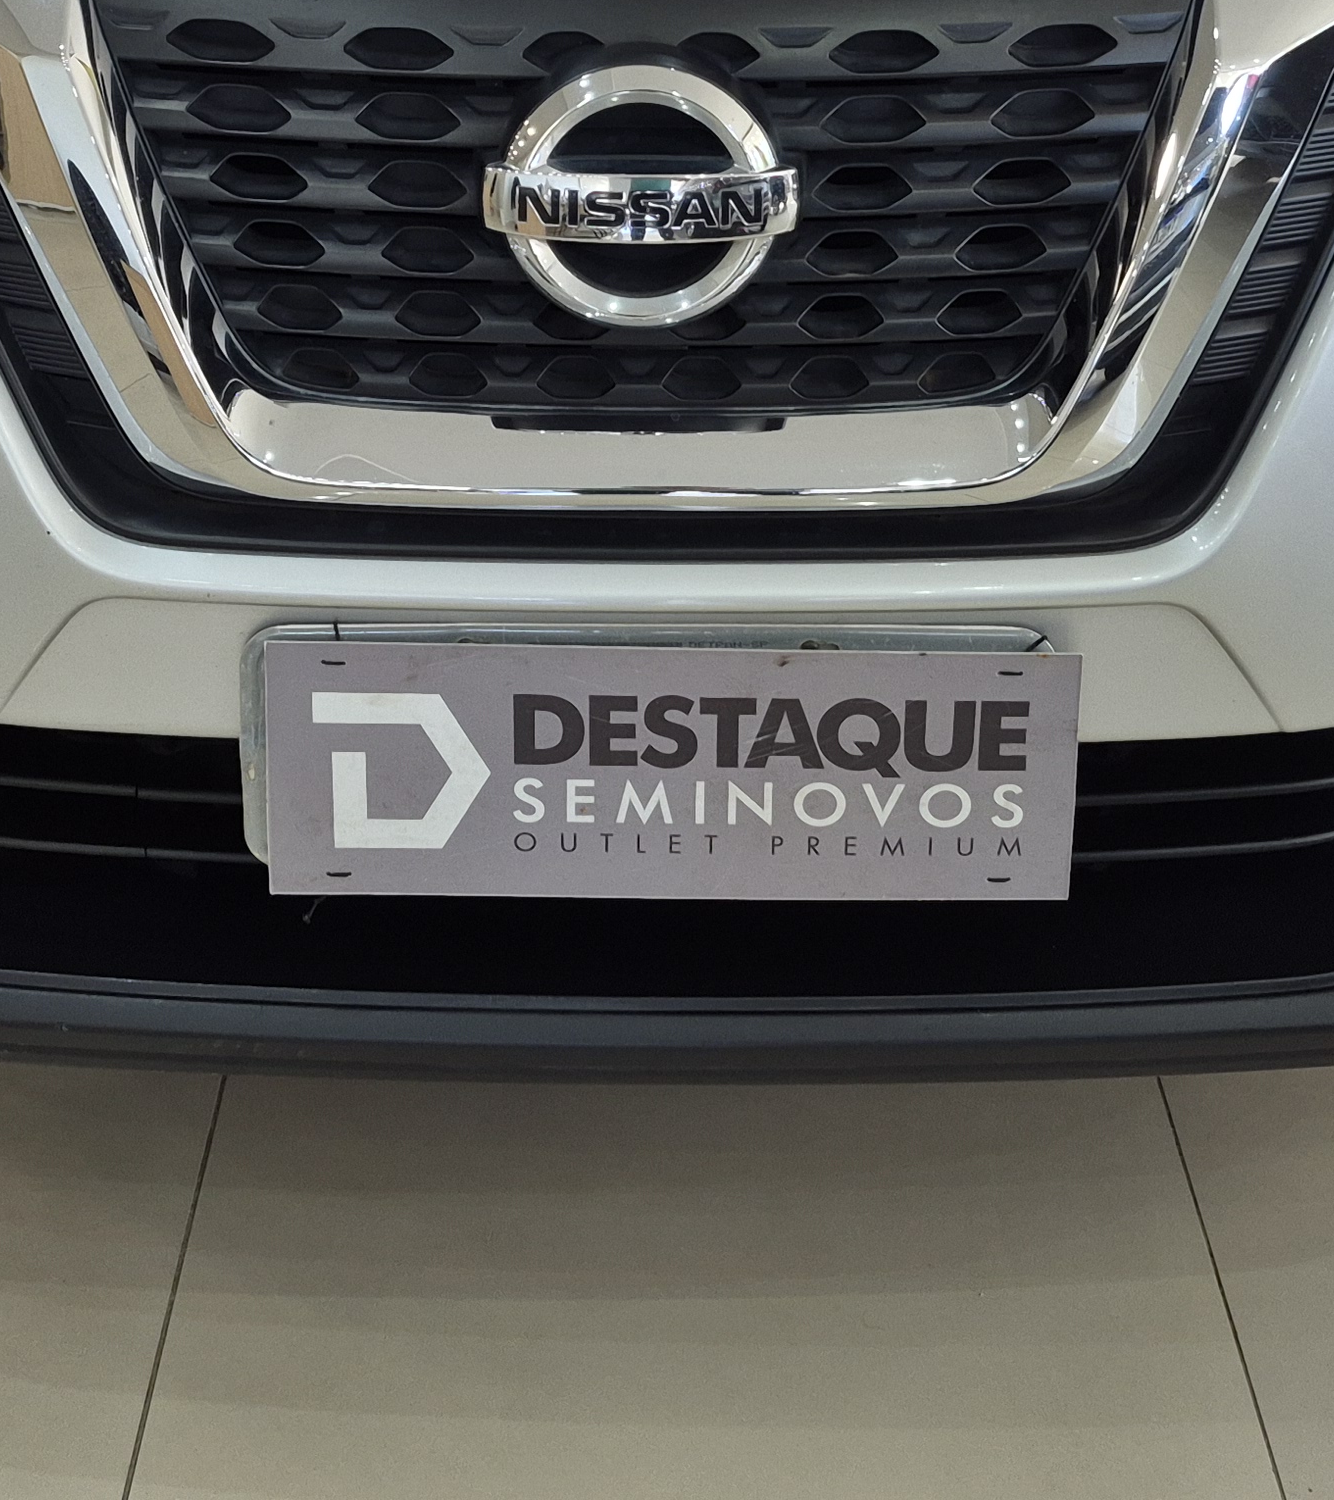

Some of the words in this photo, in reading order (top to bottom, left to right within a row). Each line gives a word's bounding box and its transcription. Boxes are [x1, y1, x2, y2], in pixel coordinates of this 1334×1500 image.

[516, 186, 768, 228] NISSAN
[512, 693, 1030, 778] DESTAQUE
[512, 778, 1025, 828] SEMINOVOS
[513, 832, 720, 854] OUTLET
[771, 835, 1024, 859] PREMIUM
